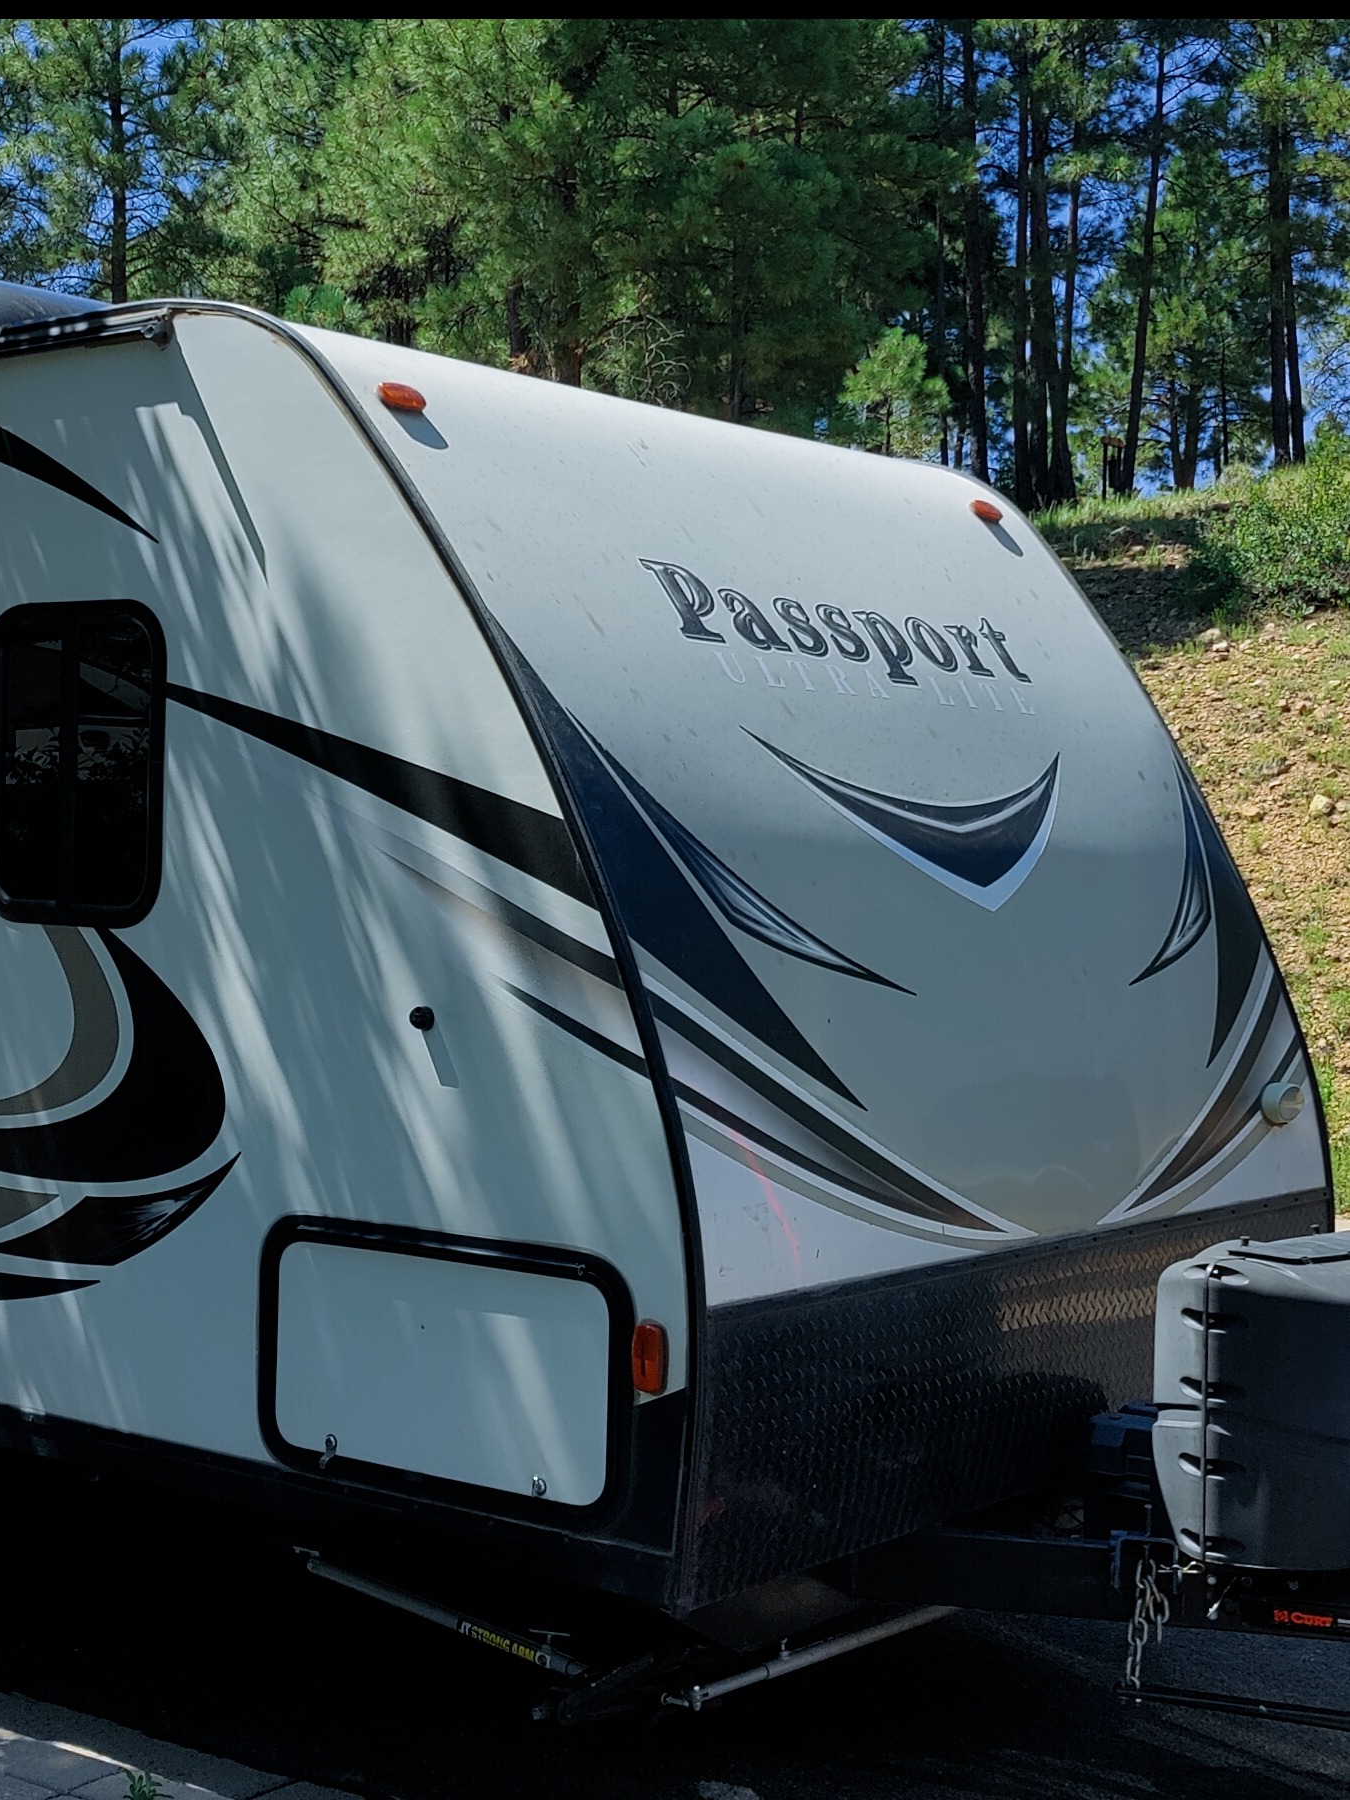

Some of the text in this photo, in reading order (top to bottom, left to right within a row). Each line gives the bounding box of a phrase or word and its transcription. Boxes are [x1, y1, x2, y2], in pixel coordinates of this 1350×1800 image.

[638, 557, 1033, 686] Passport
[714, 650, 1036, 716] ULTRA LITE
[471, 1625, 511, 1653] STRONG
[512, 1642, 535, 1663] ARM
